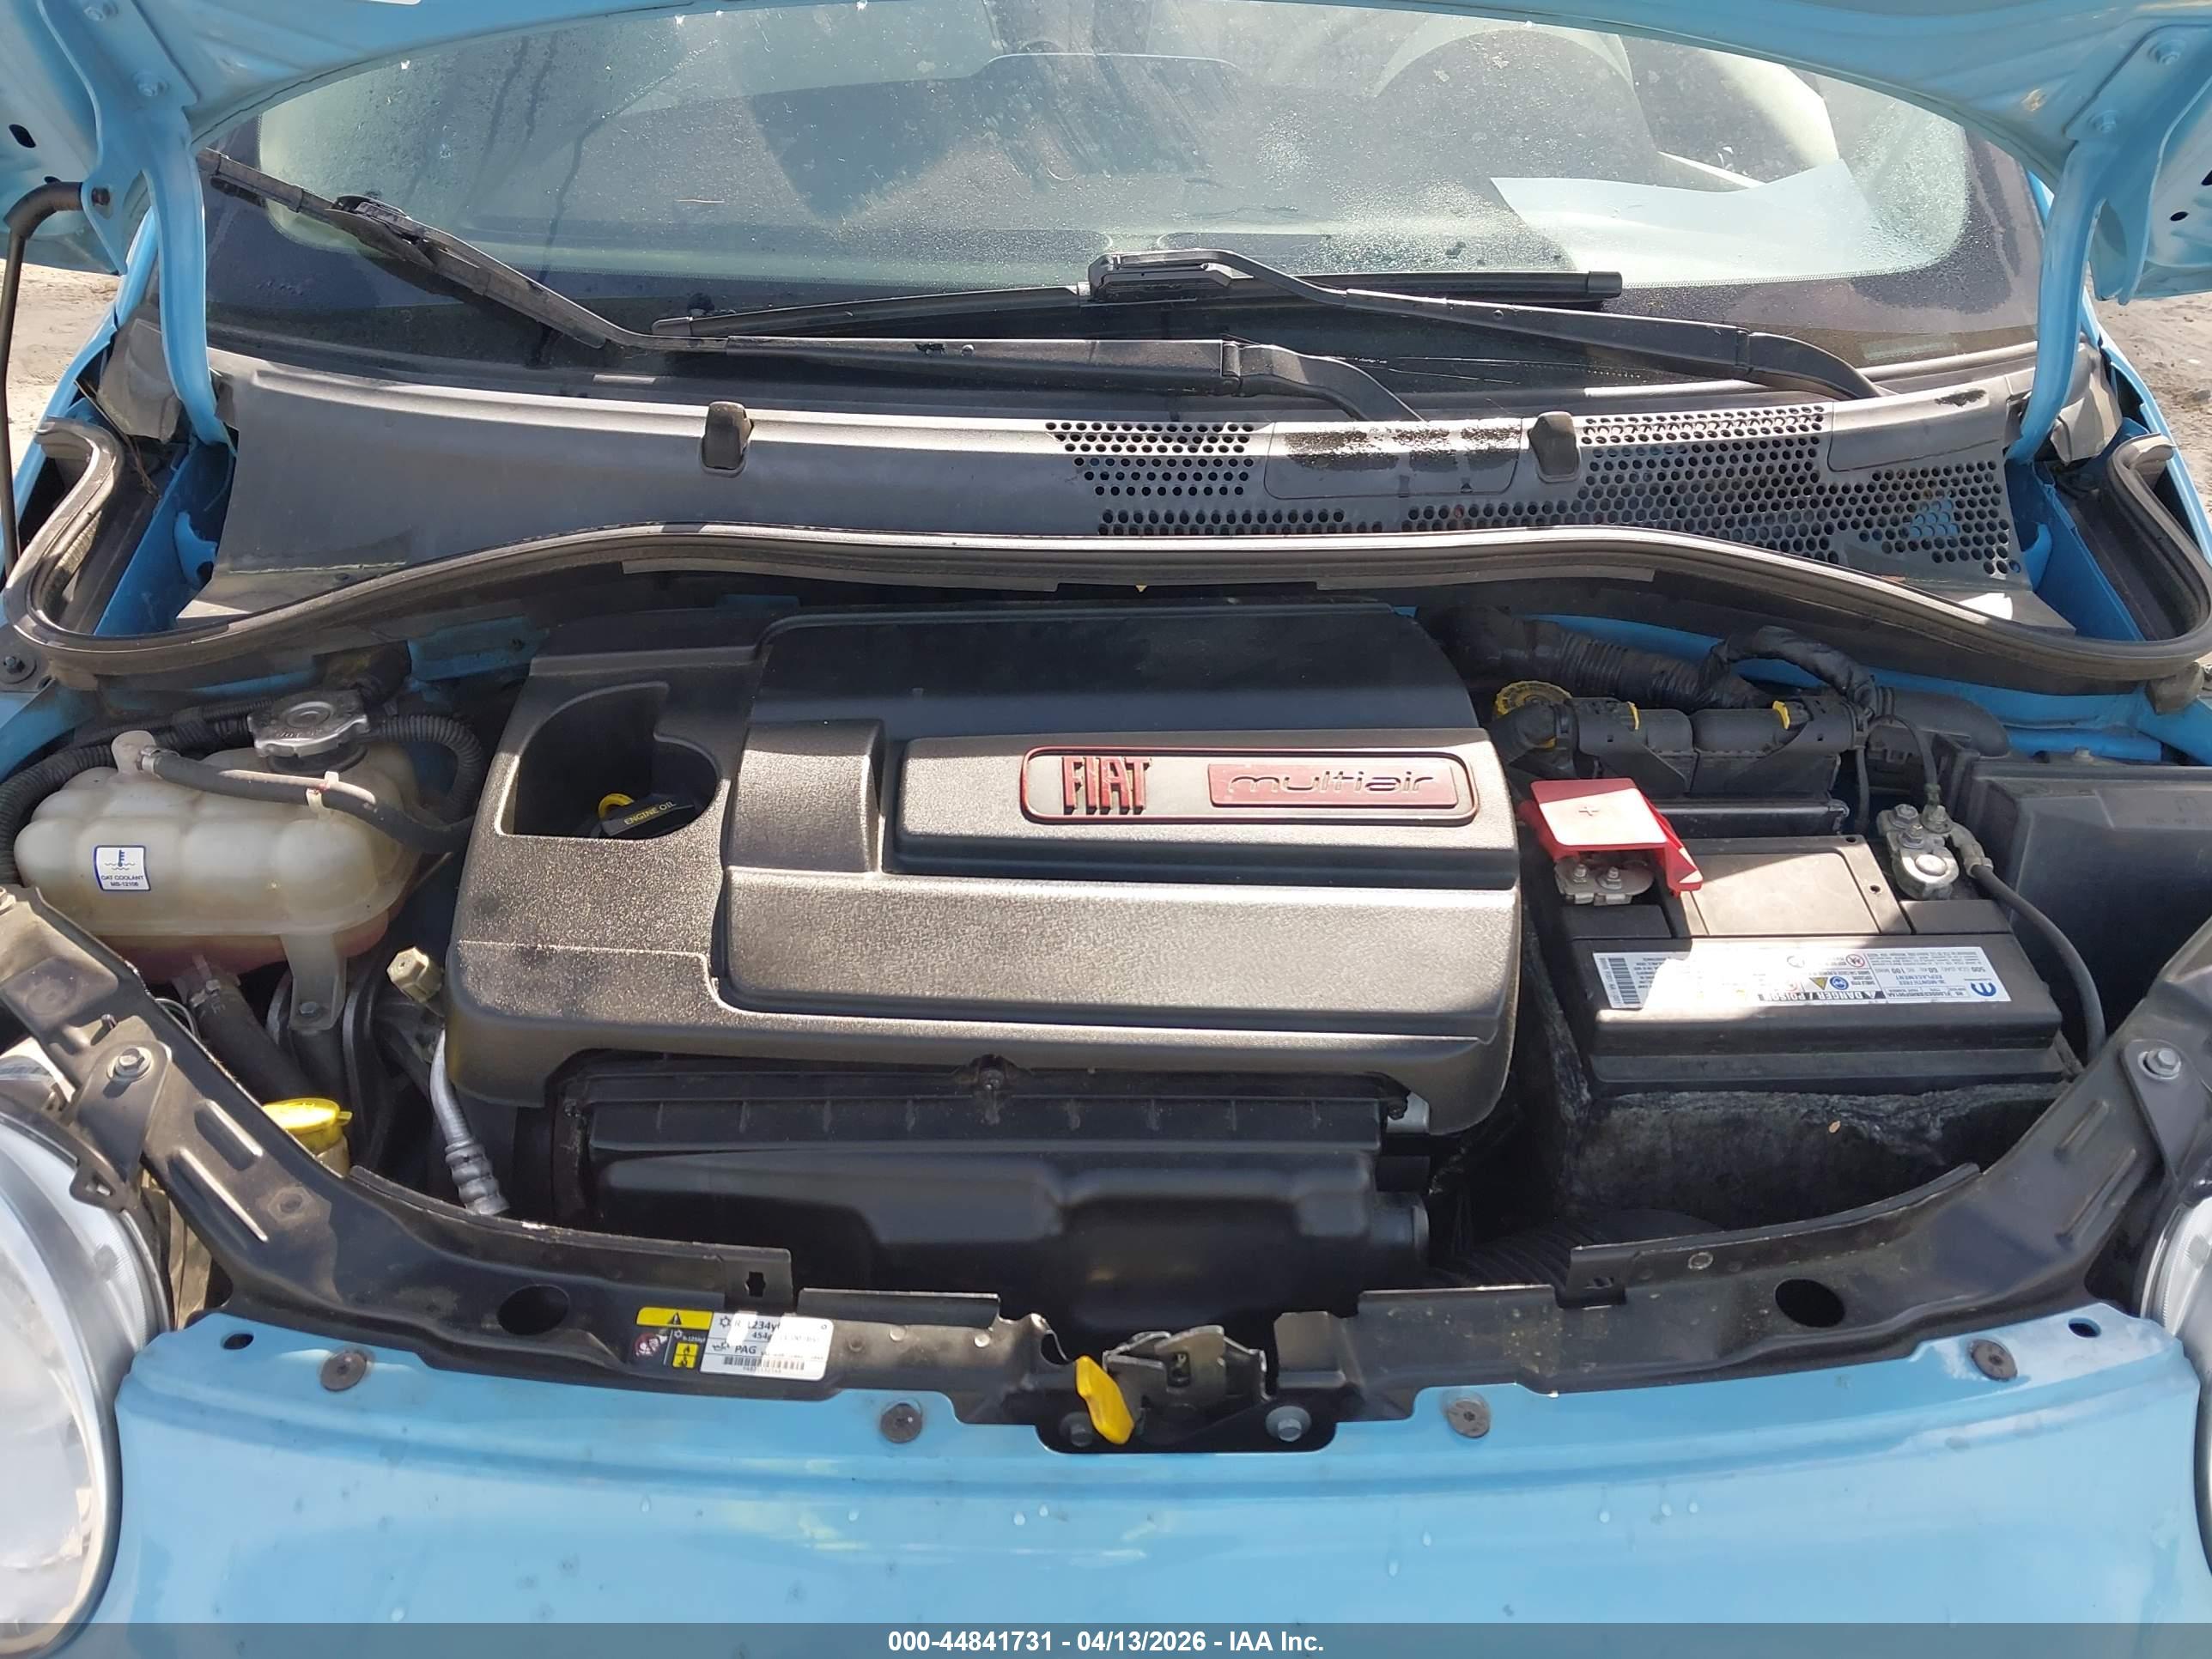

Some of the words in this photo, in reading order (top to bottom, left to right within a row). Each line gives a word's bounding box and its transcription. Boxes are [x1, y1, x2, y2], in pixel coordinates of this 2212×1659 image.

[1060, 755, 1151, 815] FIAT
[1227, 769, 1435, 793] multiair
[623, 807, 659, 825] ENGINE
[659, 801, 677, 811] OIL
[1763, 992, 1807, 1001] POISON
[1816, 990, 1864, 1000] DANGER
[734, 1346, 757, 1355] PAG
